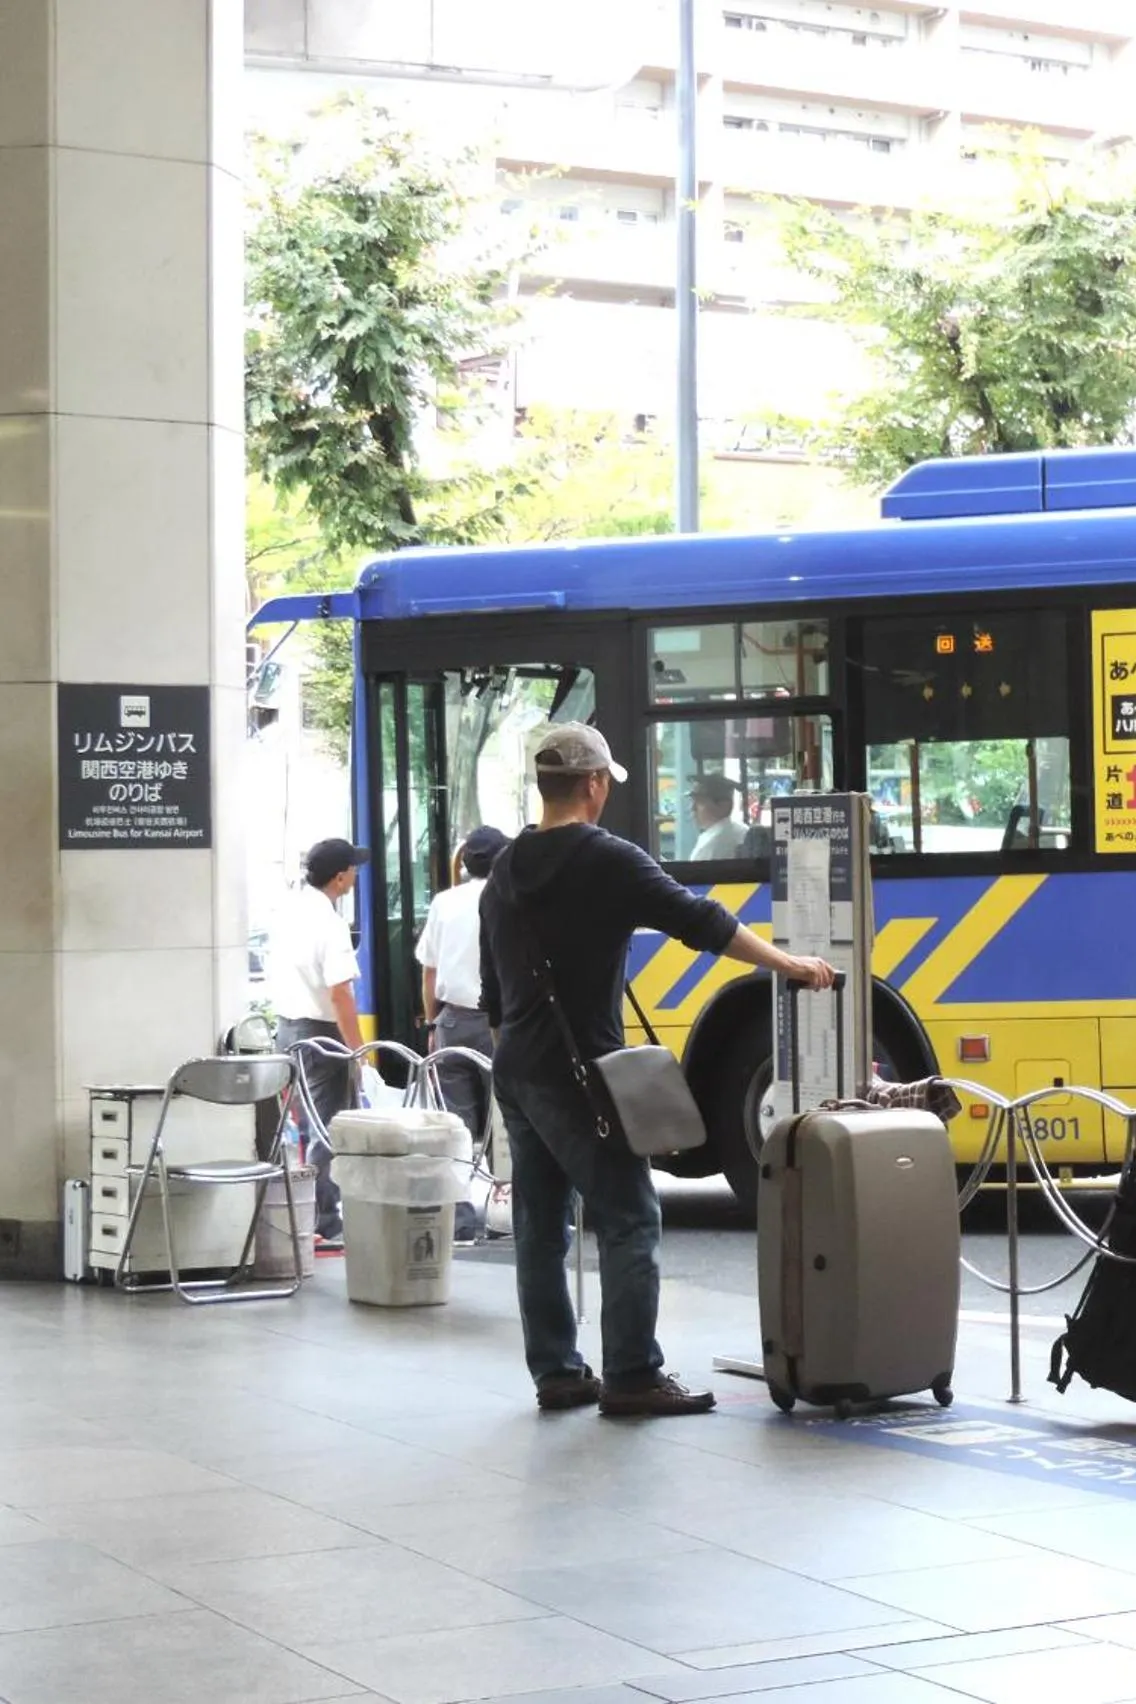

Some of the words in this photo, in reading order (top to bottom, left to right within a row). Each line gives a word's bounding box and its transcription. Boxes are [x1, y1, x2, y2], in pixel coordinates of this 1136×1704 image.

[74, 732, 197, 753] リムジンバス
[81, 760, 189, 780] 関西空港ゆき
[109, 783, 163, 802] のりば
[1106, 765, 1123, 809] 片道
[68, 828, 111, 838] Limousine
[113, 829, 128, 838] Bus
[130, 829, 142, 838] for
[144, 829, 171, 838] Kansai
[173, 828, 203, 840] Airport
